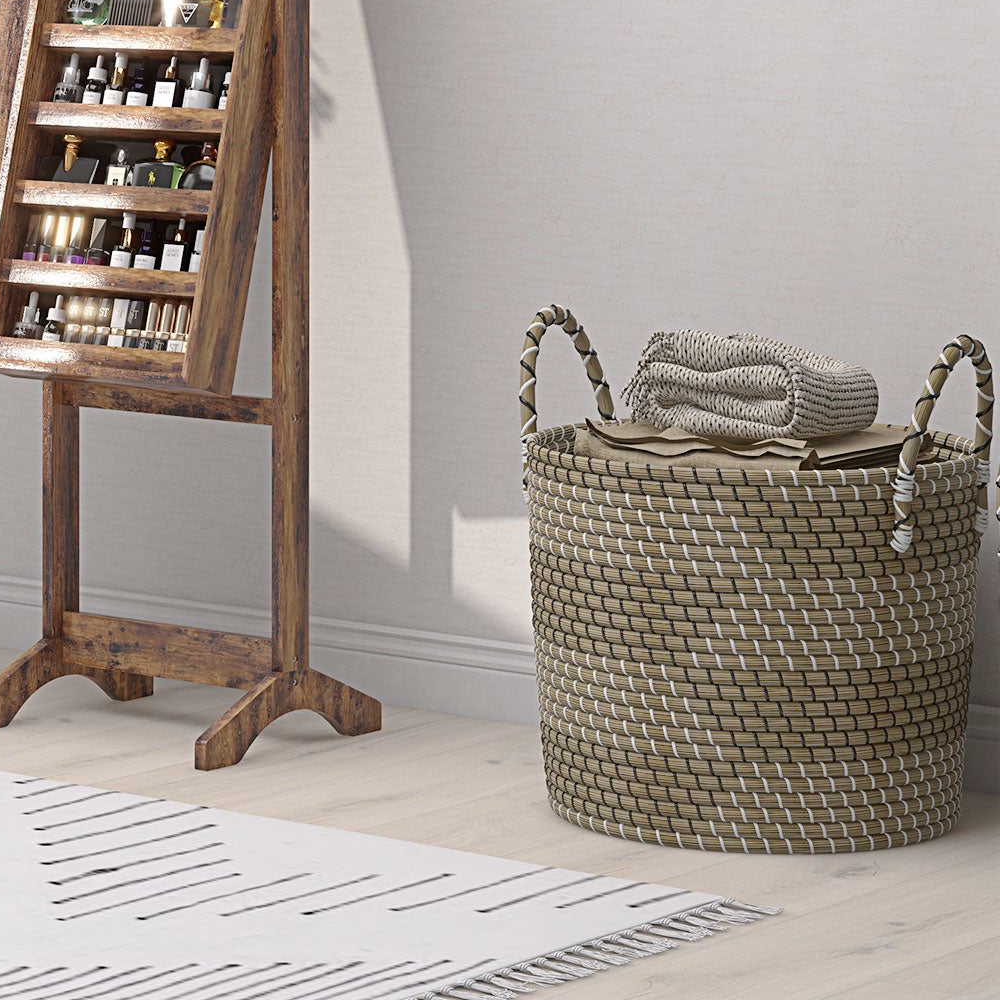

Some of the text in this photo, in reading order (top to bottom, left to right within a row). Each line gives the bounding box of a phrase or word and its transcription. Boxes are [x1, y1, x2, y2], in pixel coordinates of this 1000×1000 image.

[69, 304, 79, 315] ST
[84, 305, 95, 316] ST
[99, 307, 109, 317] ST
[114, 308, 125, 318] ST
[129, 309, 139, 320] ST
